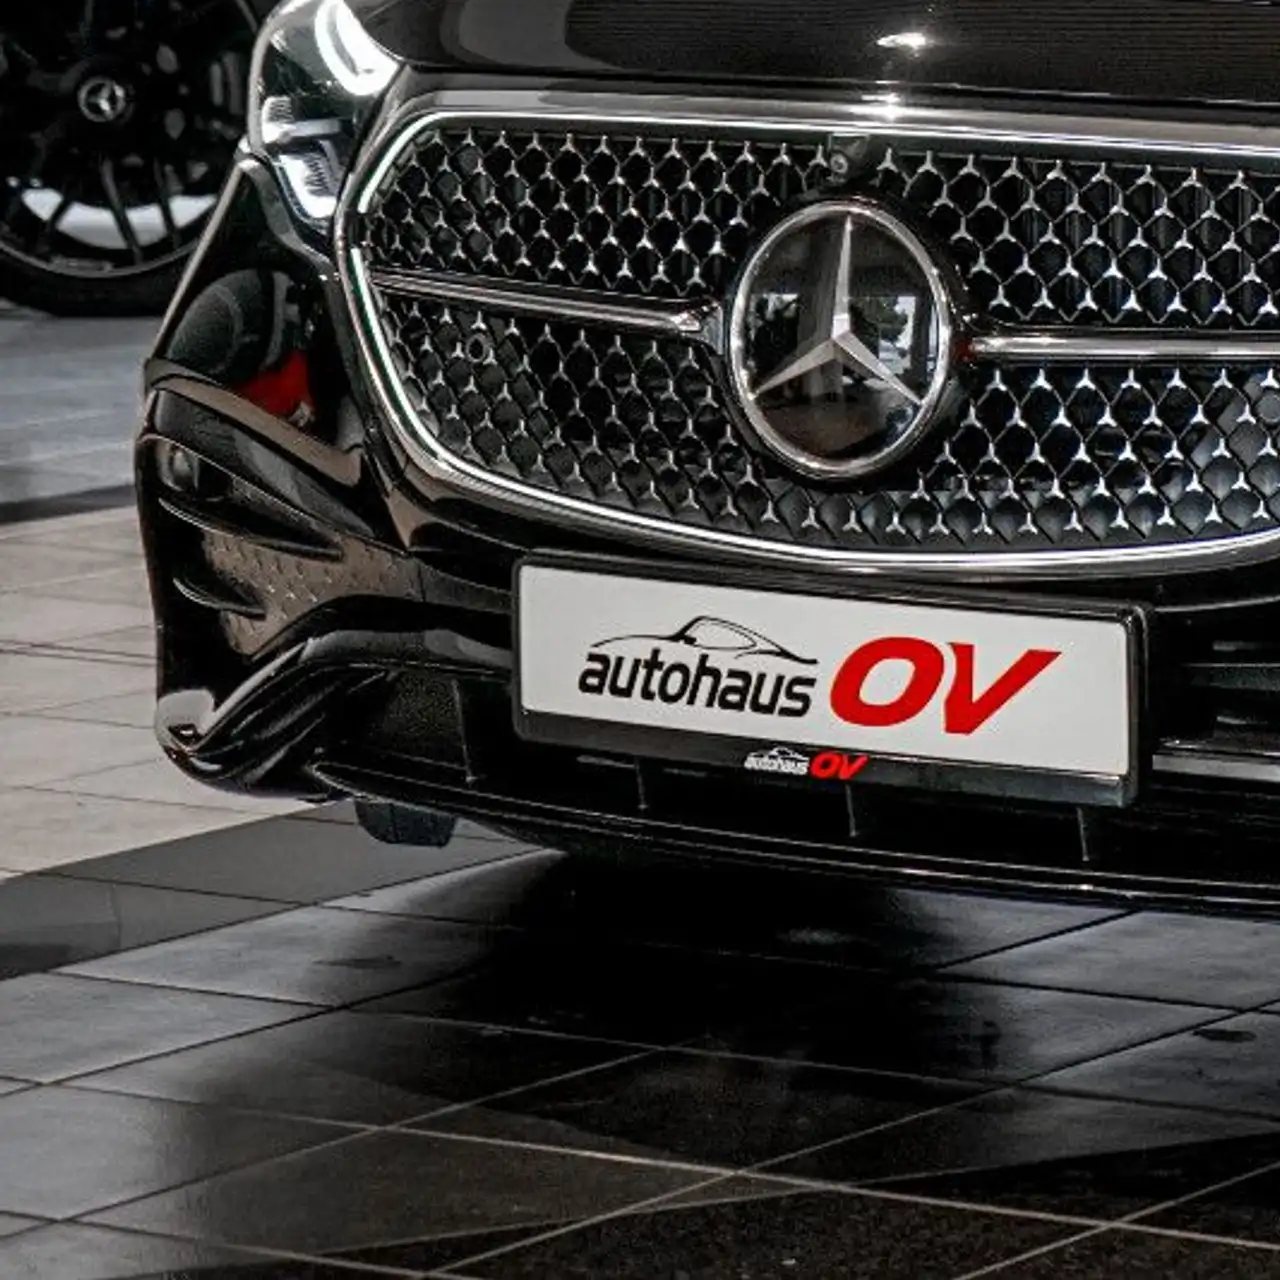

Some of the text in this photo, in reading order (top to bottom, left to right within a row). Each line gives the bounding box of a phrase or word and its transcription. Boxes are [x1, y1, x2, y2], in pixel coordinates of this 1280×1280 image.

[578, 636, 1061, 734] autohaus OV
[809, 750, 868, 780] OV
